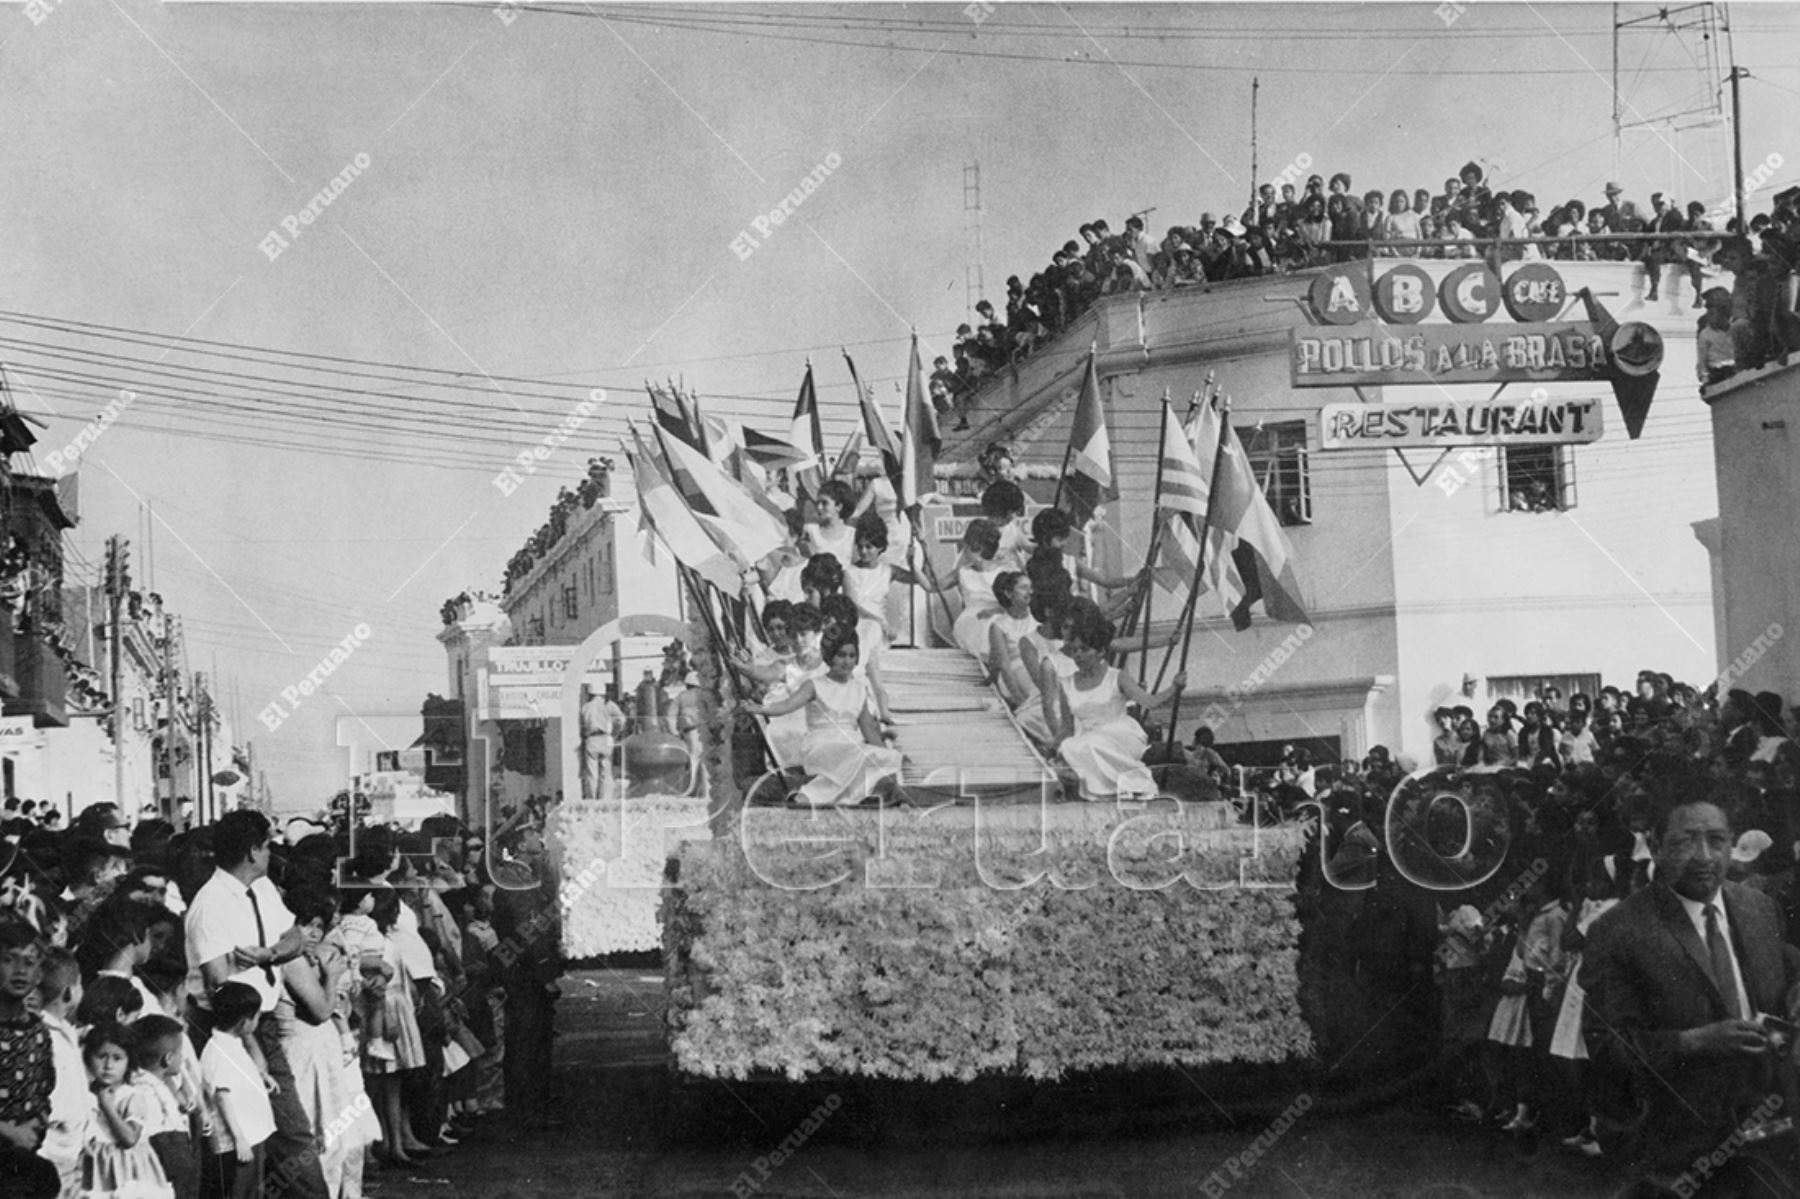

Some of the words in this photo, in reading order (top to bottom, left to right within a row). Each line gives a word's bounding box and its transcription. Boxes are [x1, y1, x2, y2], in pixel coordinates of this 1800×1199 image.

[1297, 336, 1426, 373] POLLOS
[1506, 333, 1608, 370] BRASA
[1329, 399, 1596, 441] RESTAURANT
[495, 659, 564, 673] TRUJILLO
